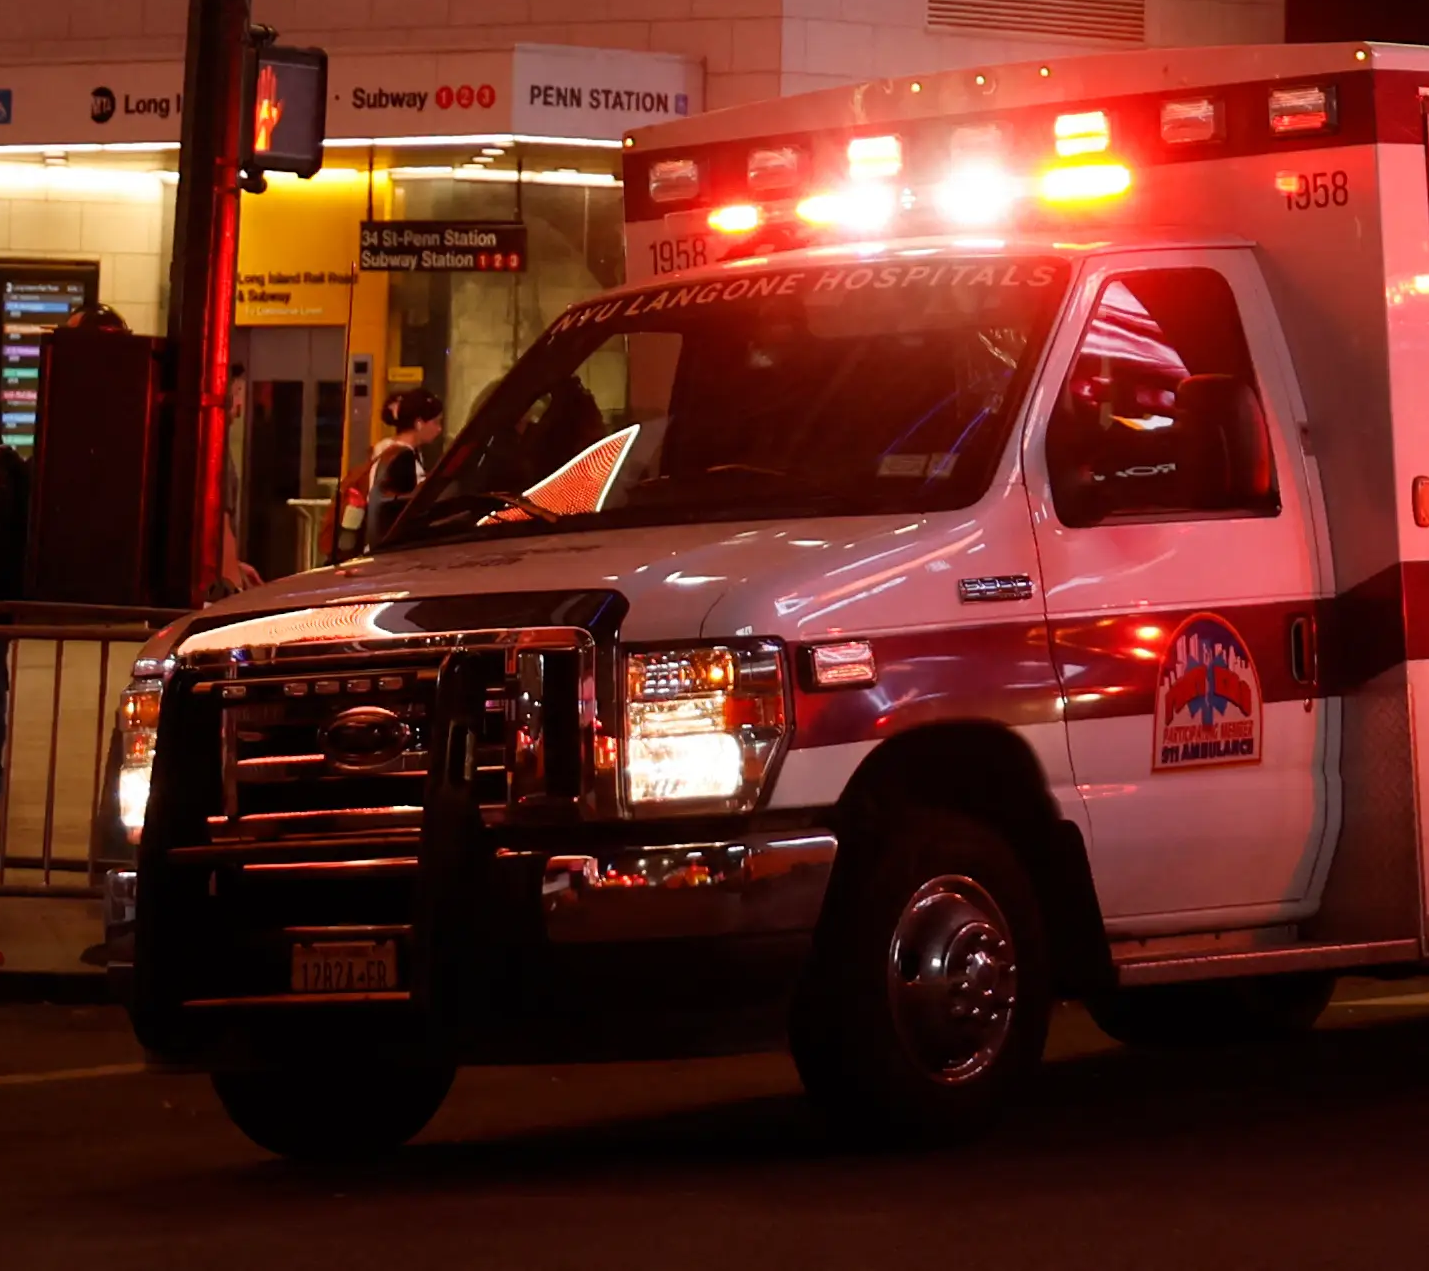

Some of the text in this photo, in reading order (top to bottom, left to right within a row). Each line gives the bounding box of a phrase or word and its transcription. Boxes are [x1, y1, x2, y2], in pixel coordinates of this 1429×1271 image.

[125, 94, 171, 118] Long
[352, 87, 428, 112] Subway
[529, 84, 669, 115] PENN STATION
[362, 230, 378, 246] 34
[444, 229, 497, 247] Station
[361, 250, 417, 270] Subway
[421, 250, 474, 268] Station
[649, 239, 706, 275] 1958
[551, 263, 1056, 336] NYU LANGONE HOSPITALS
[1181, 738, 1254, 761] AMBULANCE
